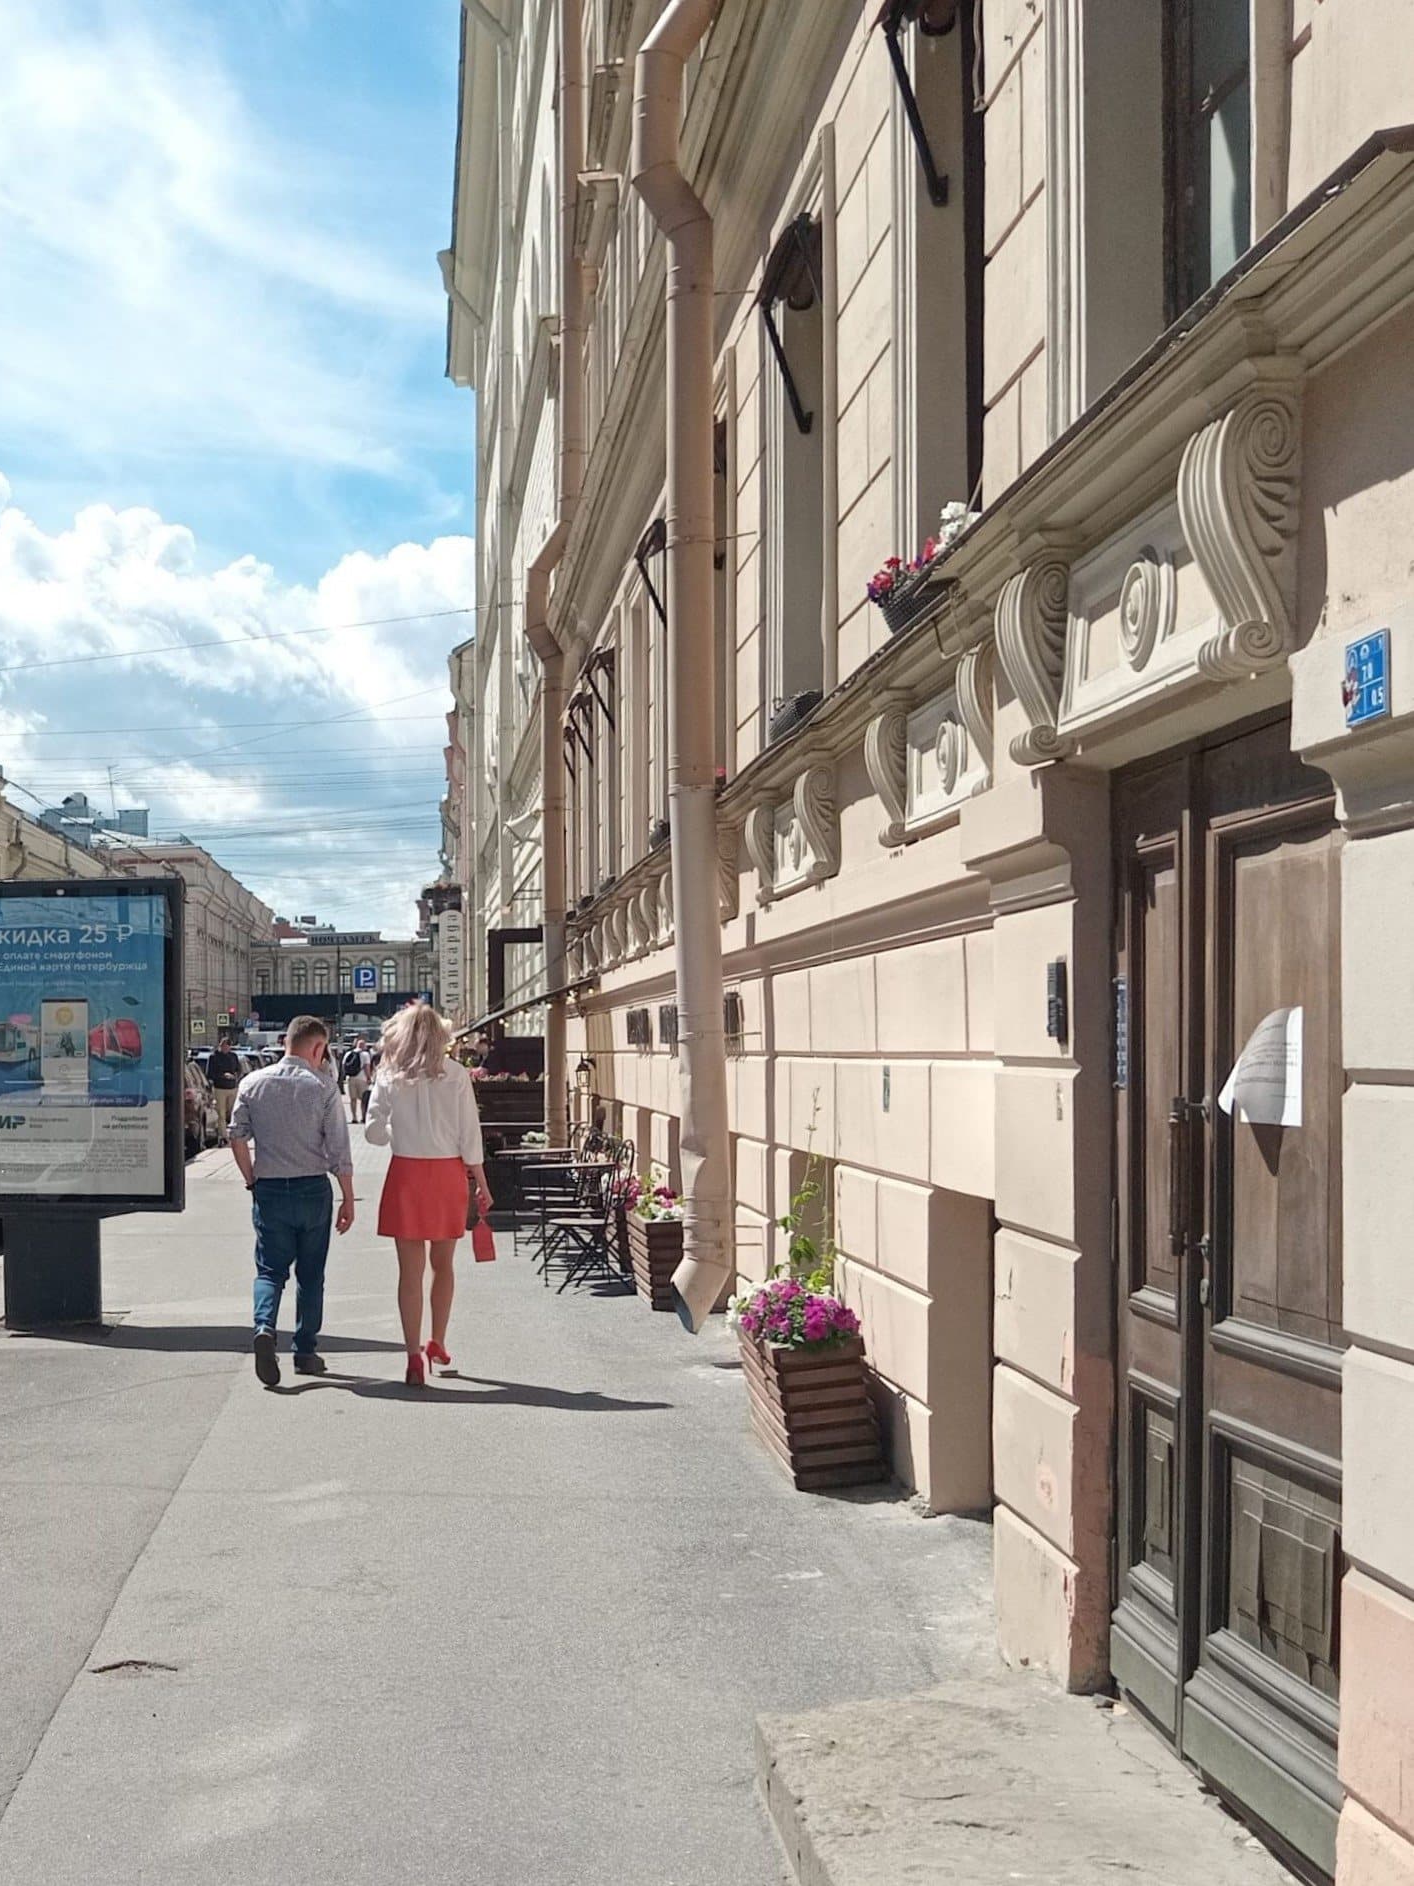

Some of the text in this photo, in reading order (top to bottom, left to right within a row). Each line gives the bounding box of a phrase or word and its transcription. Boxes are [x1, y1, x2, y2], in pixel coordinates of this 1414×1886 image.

[79, 924, 108, 944] 25
[3, 952, 40, 961] оплате
[43, 950, 113, 961] смартфоном
[39, 963, 71, 972] карте
[73, 961, 148, 972] петербуржца
[359, 969, 374, 987] P
